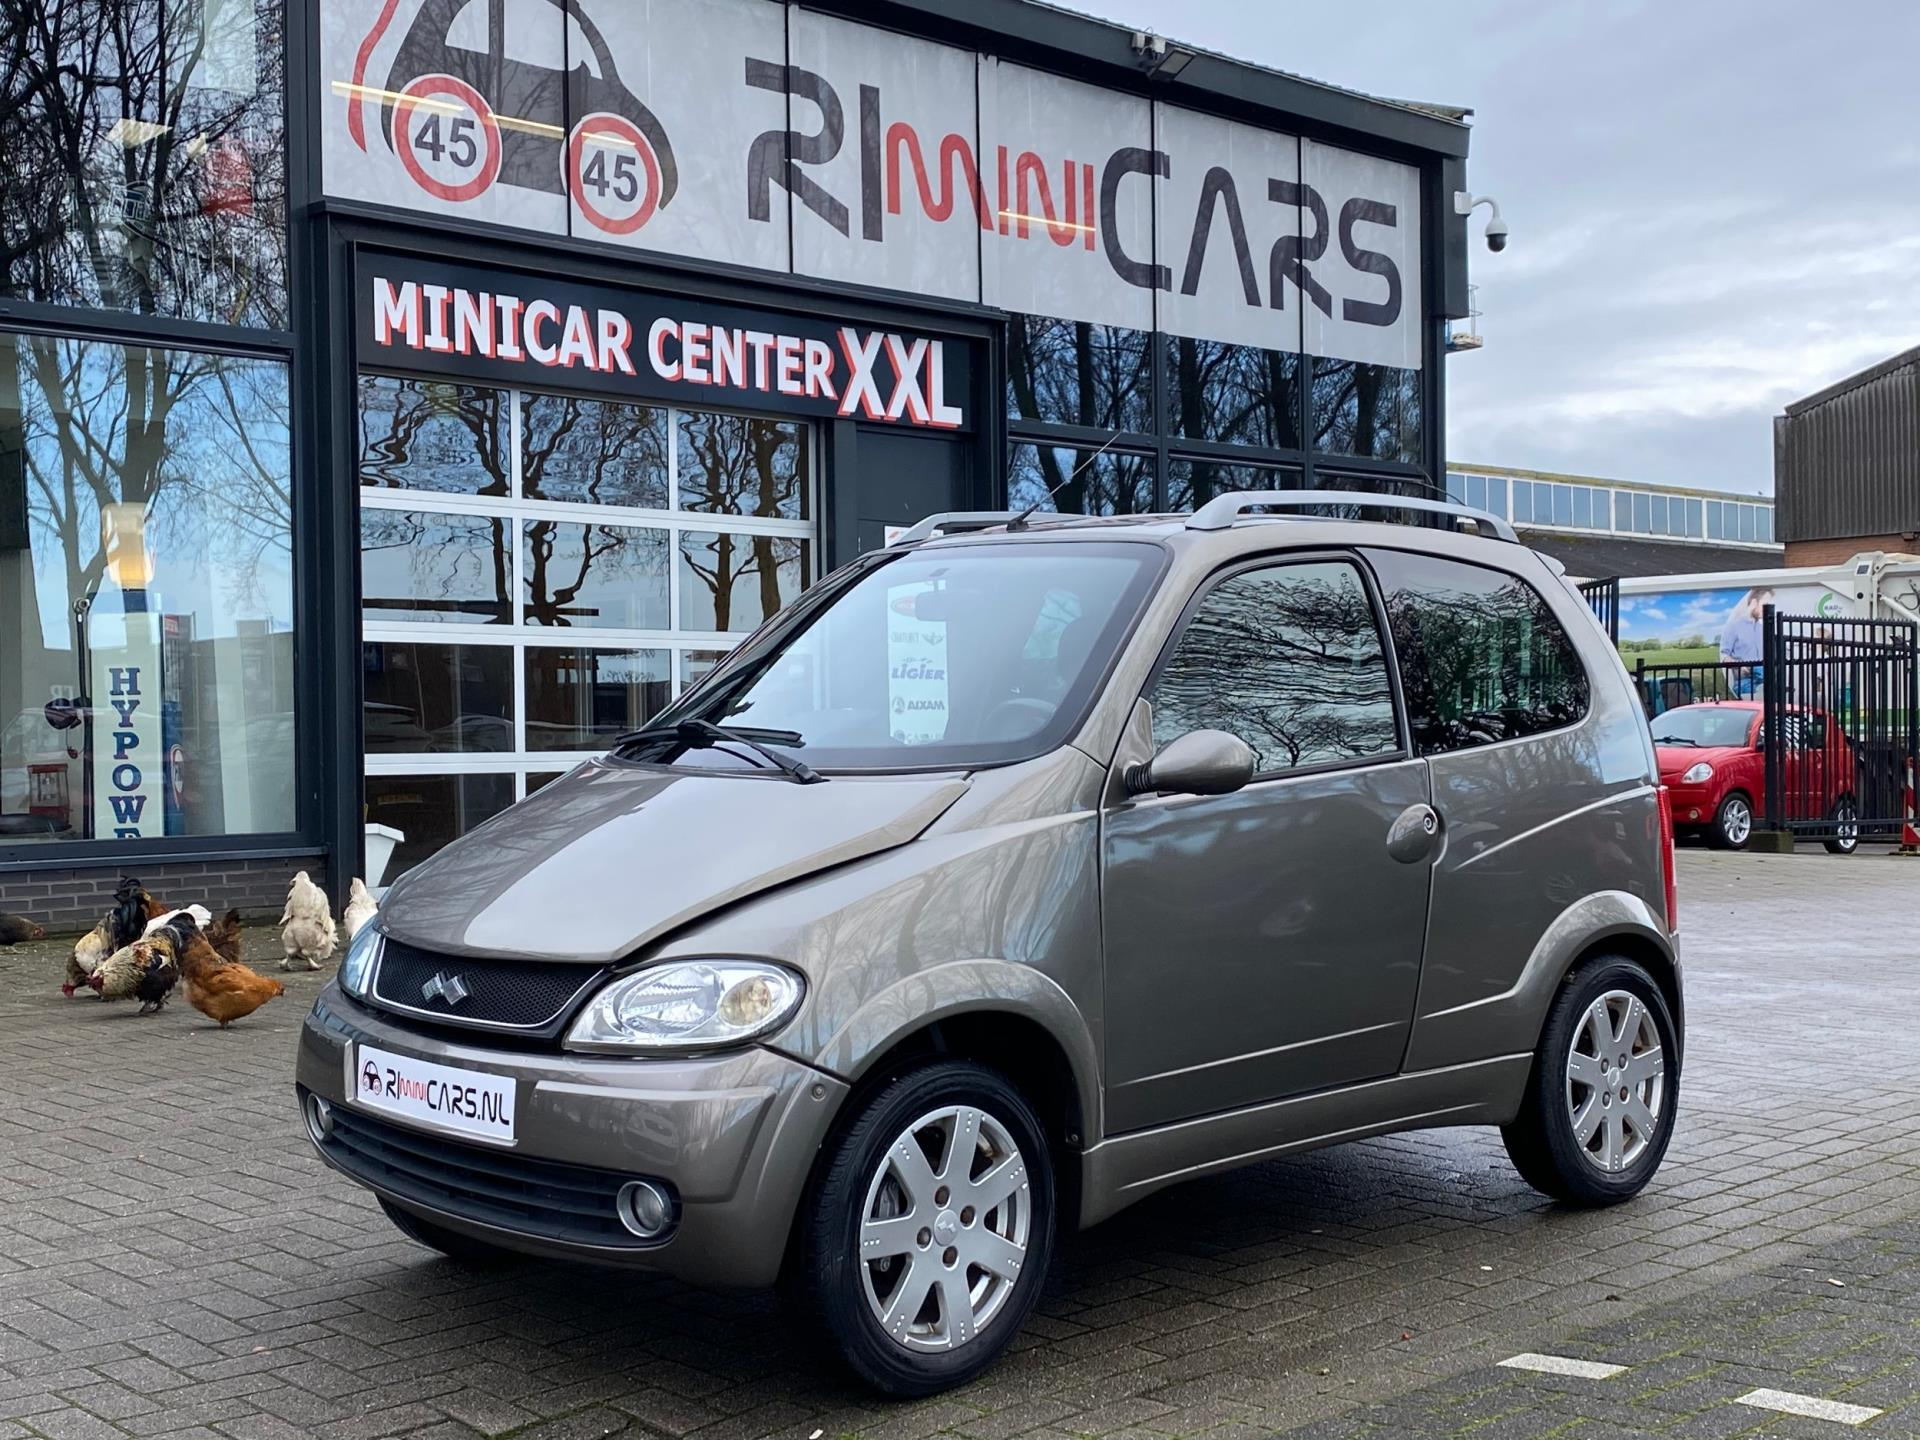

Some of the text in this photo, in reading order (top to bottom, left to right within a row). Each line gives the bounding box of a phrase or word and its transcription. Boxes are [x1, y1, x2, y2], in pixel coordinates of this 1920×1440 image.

[414, 113, 478, 168] 45
[582, 150, 639, 202] 45
[373, 277, 964, 429] MINICAR CENTER XXL
[907, 700, 945, 711] AIXAM
